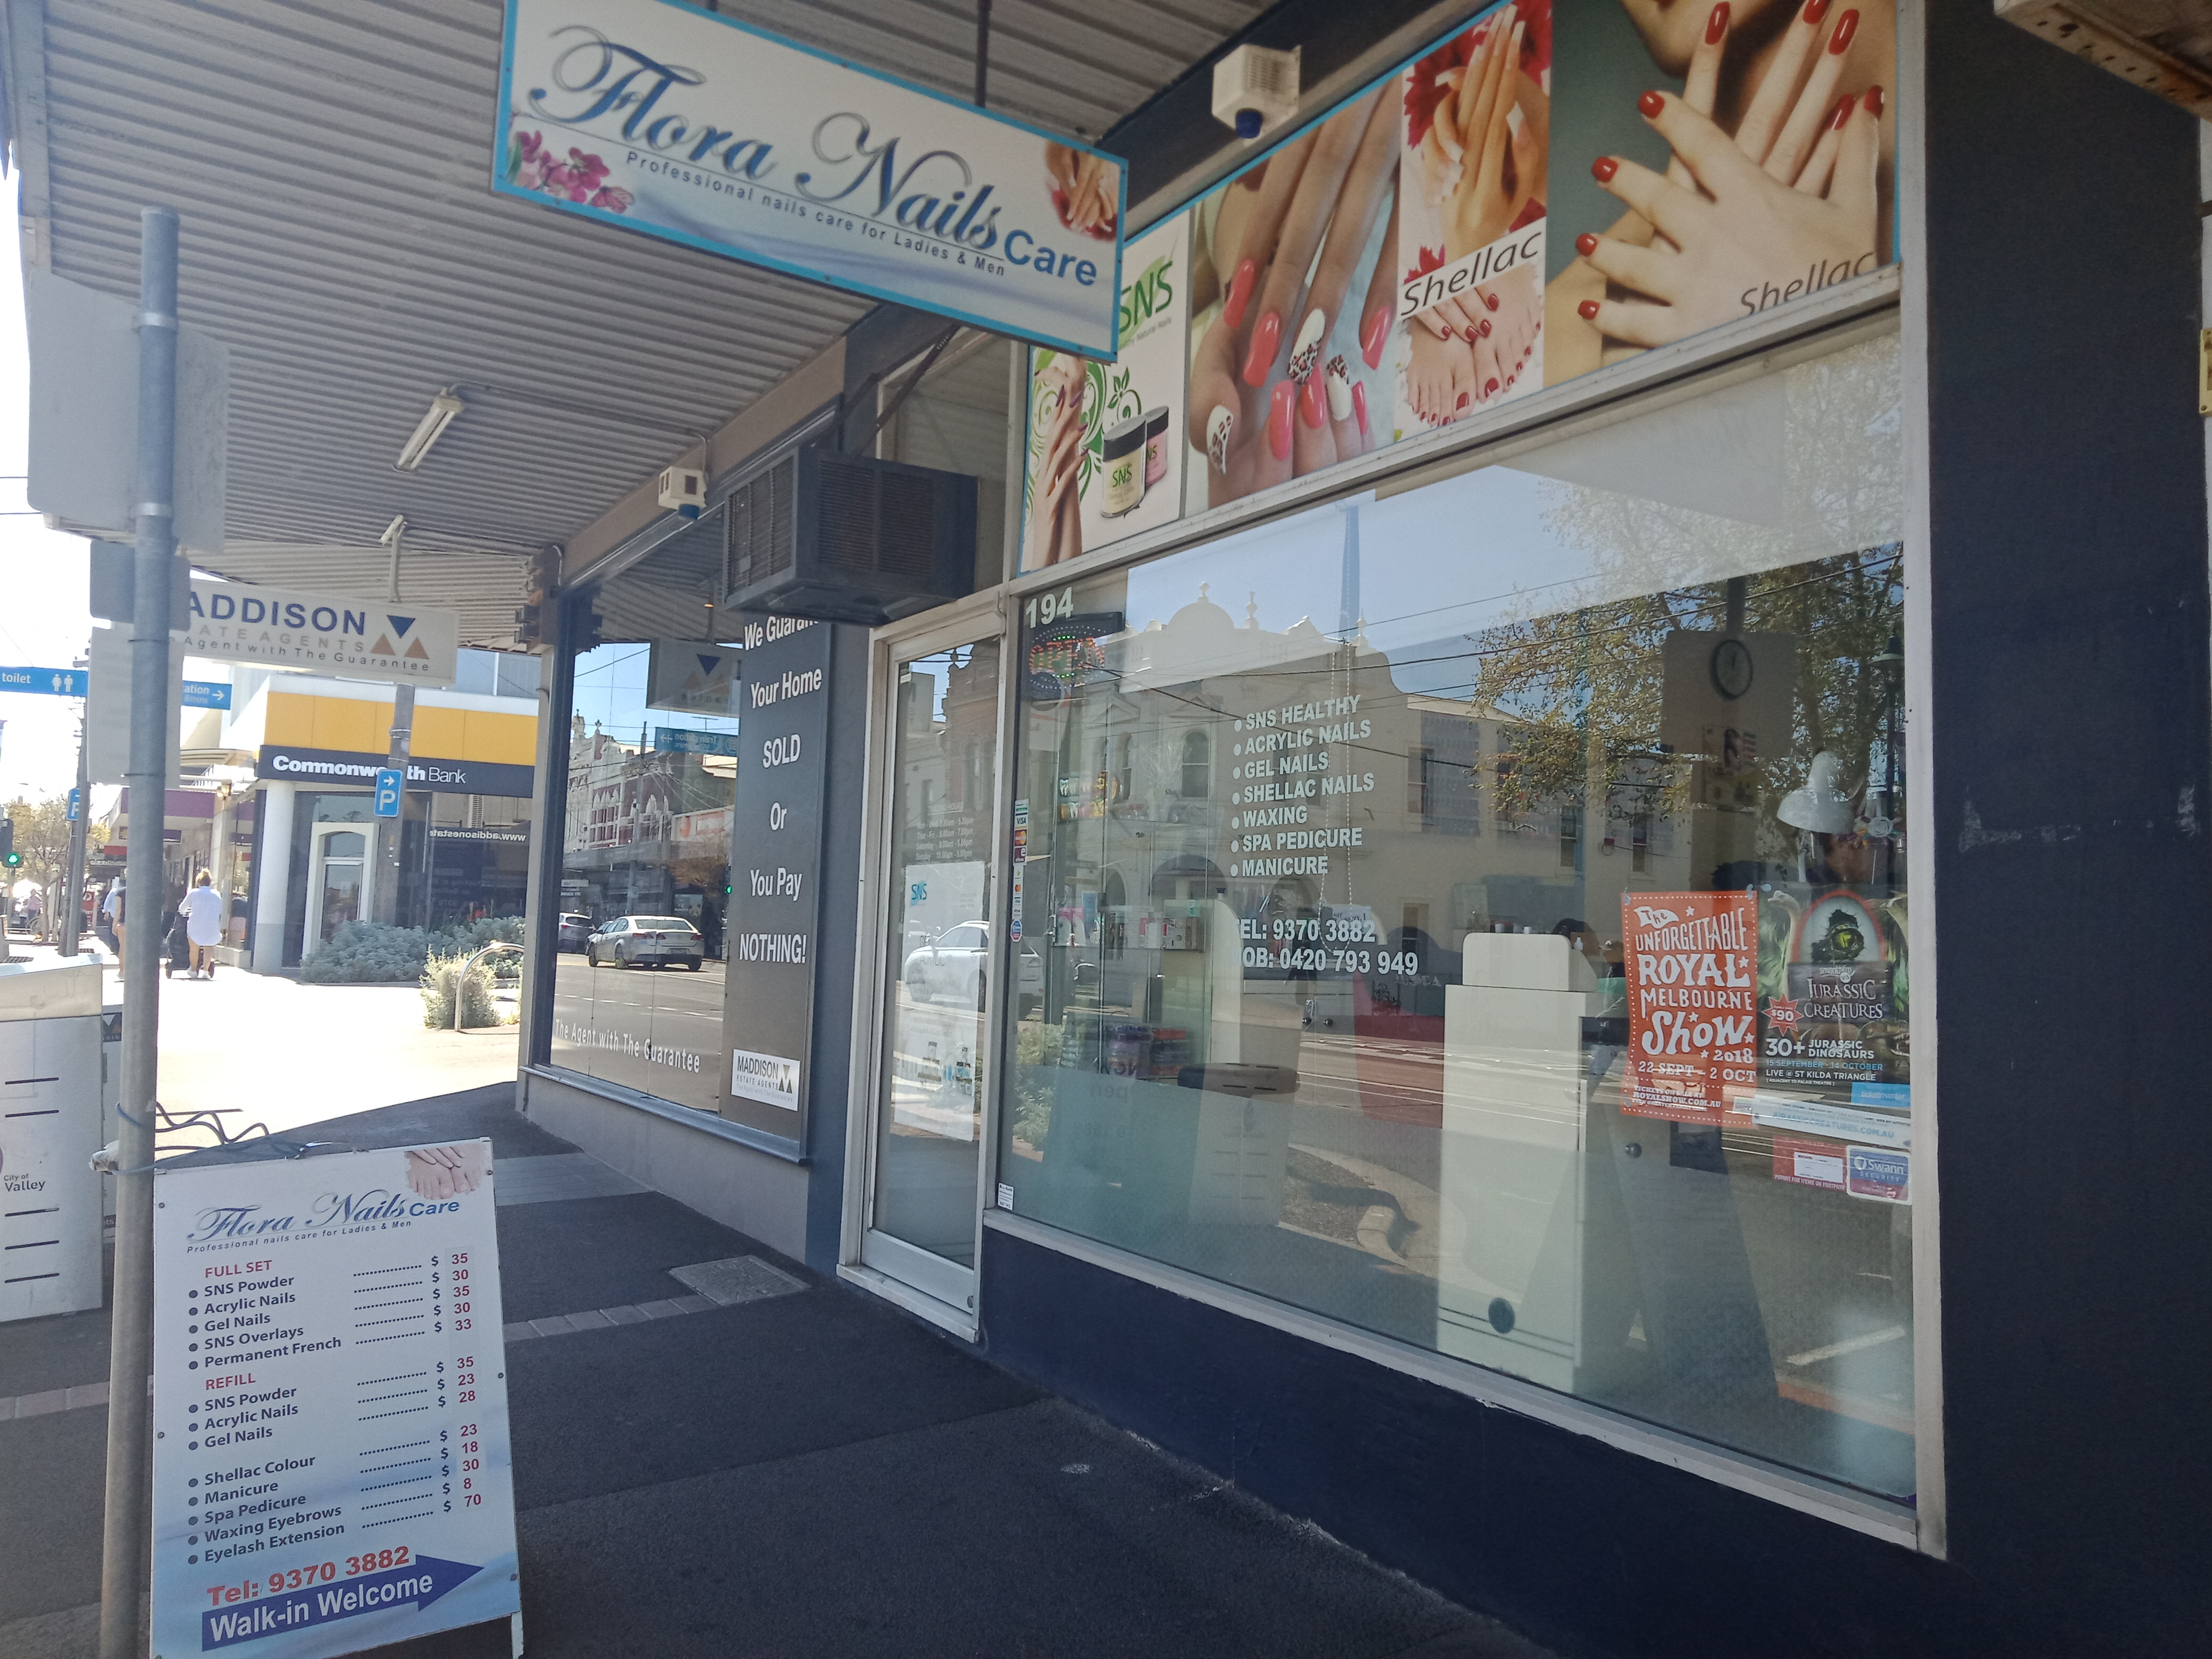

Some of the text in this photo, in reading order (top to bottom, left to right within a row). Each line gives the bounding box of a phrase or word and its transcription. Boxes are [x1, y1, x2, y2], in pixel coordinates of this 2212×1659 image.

[529, 25, 1097, 286] Flora Nails Care
[626, 150, 1004, 276] Professional nails care for Ladies & Men
[1401, 231, 1542, 316] Shellac
[1120, 261, 1173, 334] SNS
[190, 591, 365, 635] ADDISON
[1026, 586, 1074, 629] 194
[259, 631, 364, 653] AGENTS
[744, 622, 763, 651] We
[184, 636, 430, 672] Agent with The Guarantee
[2, 672, 31, 684] toilet
[183, 685, 210, 694] ation
[750, 668, 823, 709] Your Home
[1246, 694, 1360, 730] SNS HEALTHY
[762, 733, 801, 769] SOLD
[1245, 719, 1371, 754] ACRYLIC NAILS
[272, 755, 466, 784] Commonwth Bank
[1244, 751, 1329, 778] GEL NAILS
[379, 790, 396, 811] P
[1244, 773, 1375, 803] SHELLAC NAILS
[770, 801, 787, 831] Or
[1243, 805, 1308, 828] WAXING
[1242, 827, 1362, 852] SPA PEDICURE
[1242, 856, 1328, 877] MANICURE
[750, 867, 802, 902] You Pay
[911, 883, 927, 900] SNS
[1273, 918, 1319, 941] 9370
[1325, 919, 1376, 943] 3882
[1635, 907, 1749, 951] UNFORGETTABLE
[739, 933, 808, 964] NOTHING!
[1280, 948, 1418, 976] 0420 793 949
[1637, 953, 1751, 987] ROYAL
[1820, 965, 1853, 975] smoothfm
[1640, 987, 1753, 1018] MELBOURNE
[1806, 978, 1876, 1001] JURASSIC
[1772, 1009, 1795, 1021] $90
[1804, 1003, 1883, 1019] CREATURES
[556, 1019, 700, 1074] The Agent with The Guarantee
[1641, 1010, 1753, 1055] Show
[1765, 1038, 1863, 1057] 30+ JURASSIC
[738, 1055, 778, 1079] MADDISON
[1713, 1048, 1754, 1064] 2018
[1777, 1060, 1823, 1068] SEPTEMBER
[1842, 1062, 1883, 1071] OCTOBER
[1808, 1048, 1874, 1059] DINOSAURS
[736, 1075, 778, 1091] ESTATE AGENTS
[1638, 1060, 1756, 1083] 22 SEPT 2 OCT
[1807, 1071, 1831, 1079] KILDA
[1834, 1072, 1876, 1081] TRIANGLE
[1632, 1091, 1721, 1108] ROYALSHOW.COM.AU
[1634, 1085, 1664, 1095] TICKETS
[1862, 1090, 1906, 1101] ticketmaster
[1860, 1171, 1900, 1182] SECURITY
[1869, 1160, 1905, 1175] Swann
[5, 1180, 45, 1192] Valley
[1823, 1182, 1845, 1191] FOOTPATH
[187, 1189, 460, 1241] Flora Nails Care
[187, 1238, 259, 1254] Professional
[263, 1234, 290, 1244] nails
[295, 1232, 317, 1241] care
[322, 1228, 338, 1237] for
[341, 1224, 376, 1235] Ladies
[391, 1219, 412, 1228] Men
[204, 1253, 468, 1297] SNS Powder 35
[205, 1260, 273, 1278] FULL SET
[204, 1269, 469, 1316] Acrylic Nails 30
[204, 1286, 471, 1332] Gel Nails 35
[204, 1302, 472, 1351] SNS Overlays 30
[204, 1319, 472, 1368] Permanent French 33
[204, 1358, 474, 1412] SNS Powder 35
[206, 1373, 256, 1390] REFILL
[204, 1375, 475, 1431] Acrylic Nails 23
[204, 1390, 476, 1448] Gel Nails 28
[204, 1425, 477, 1486] Shellac Colour 23
[204, 1442, 479, 1505] Manicure 18
[204, 1459, 480, 1527] Spa Pedicure 30
[204, 1478, 472, 1545] Waxing Eyebrows 8
[204, 1495, 482, 1564] Eyelash Extension 70
[206, 1546, 410, 1607] Tel: 9370 3882
[210, 1572, 433, 1643] Walk-in Welcome
